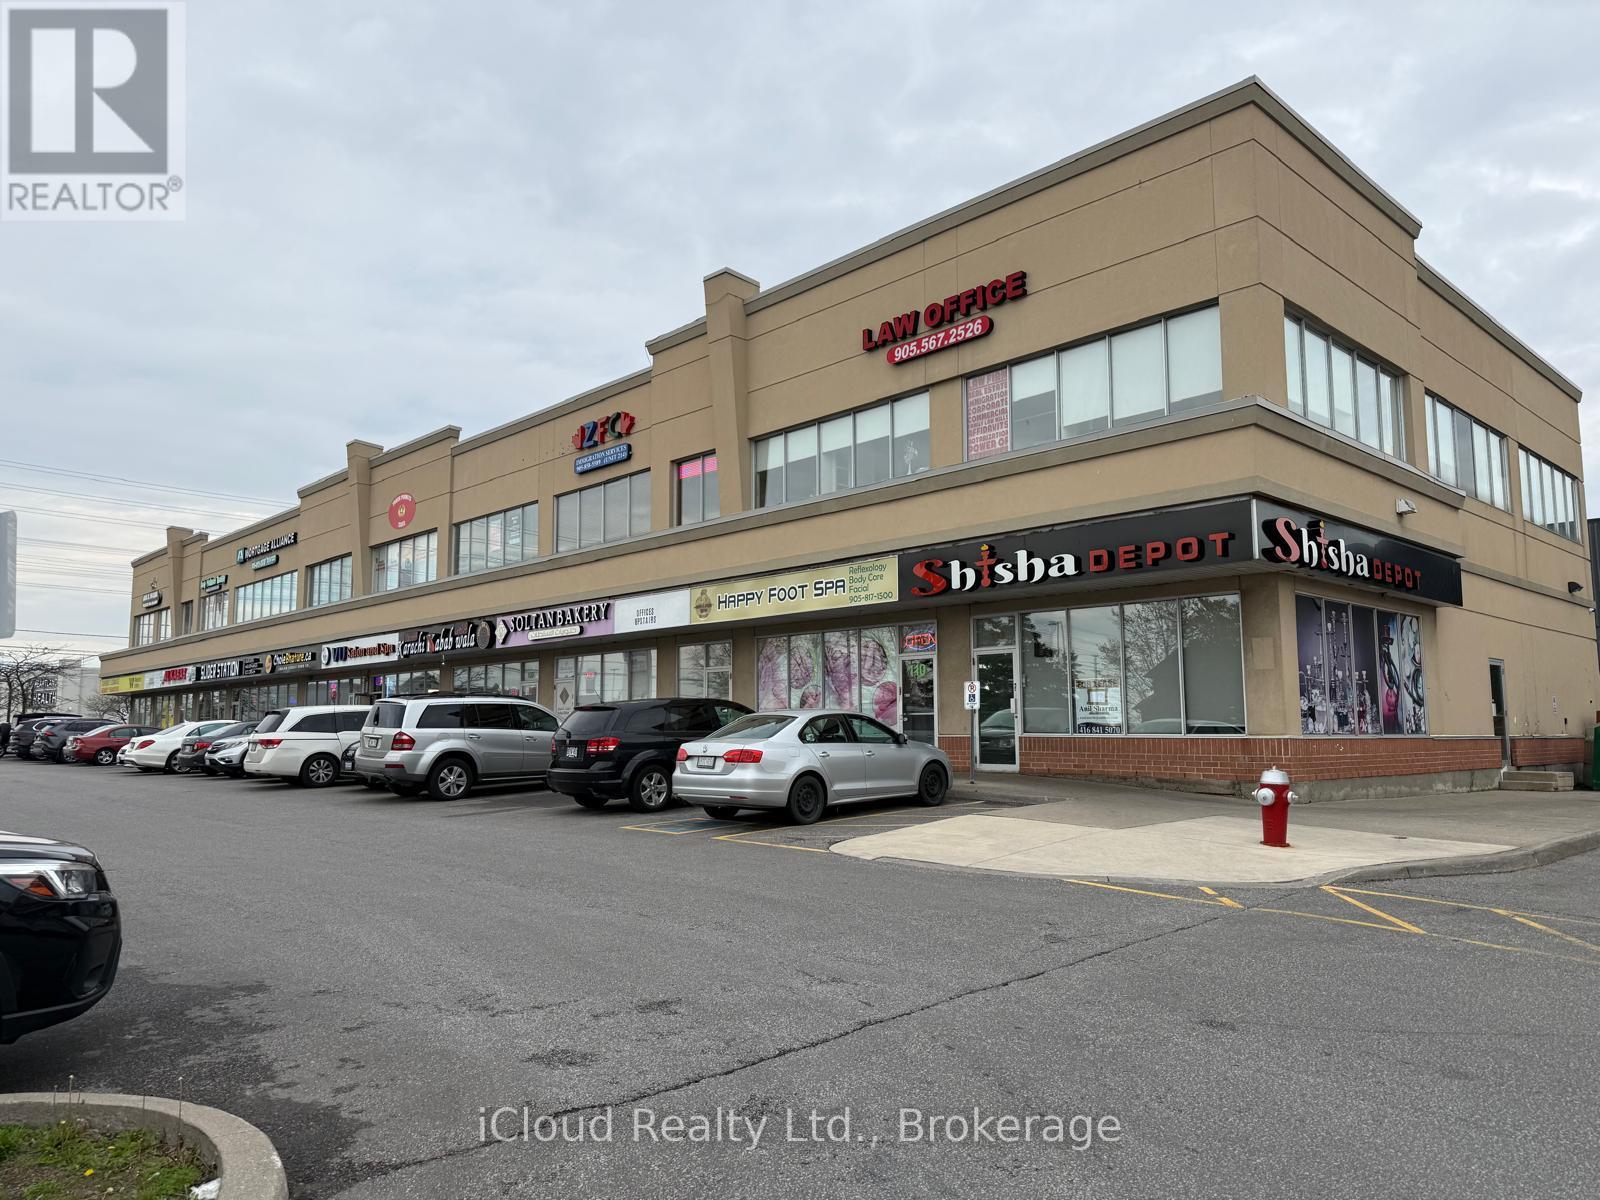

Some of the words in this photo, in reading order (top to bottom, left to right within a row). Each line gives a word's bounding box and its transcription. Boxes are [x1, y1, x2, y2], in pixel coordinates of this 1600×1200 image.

[863, 310, 920, 352] LAW
[924, 271, 1028, 328] OFFICE
[894, 319, 982, 361] 905.567.2526
[270, 532, 295, 550] ALLIANCE
[1274, 517, 1370, 577] Shisha
[1373, 558, 1422, 590] DEPOT
[849, 563, 887, 575] Reflexology
[911, 544, 1080, 596] Shisha
[1089, 532, 1233, 573] DEPOT
[849, 575, 866, 584] Body
[868, 573, 883, 581] Care
[849, 584, 869, 593] Facial
[717, 590, 763, 610] HAPPY
[768, 583, 808, 603] FOOT
[813, 578, 846, 597] SPA
[849, 591, 893, 603] 905-817-1500
[557, 602, 609, 625] BAKERY
[636, 607, 654, 617] OFFICES
